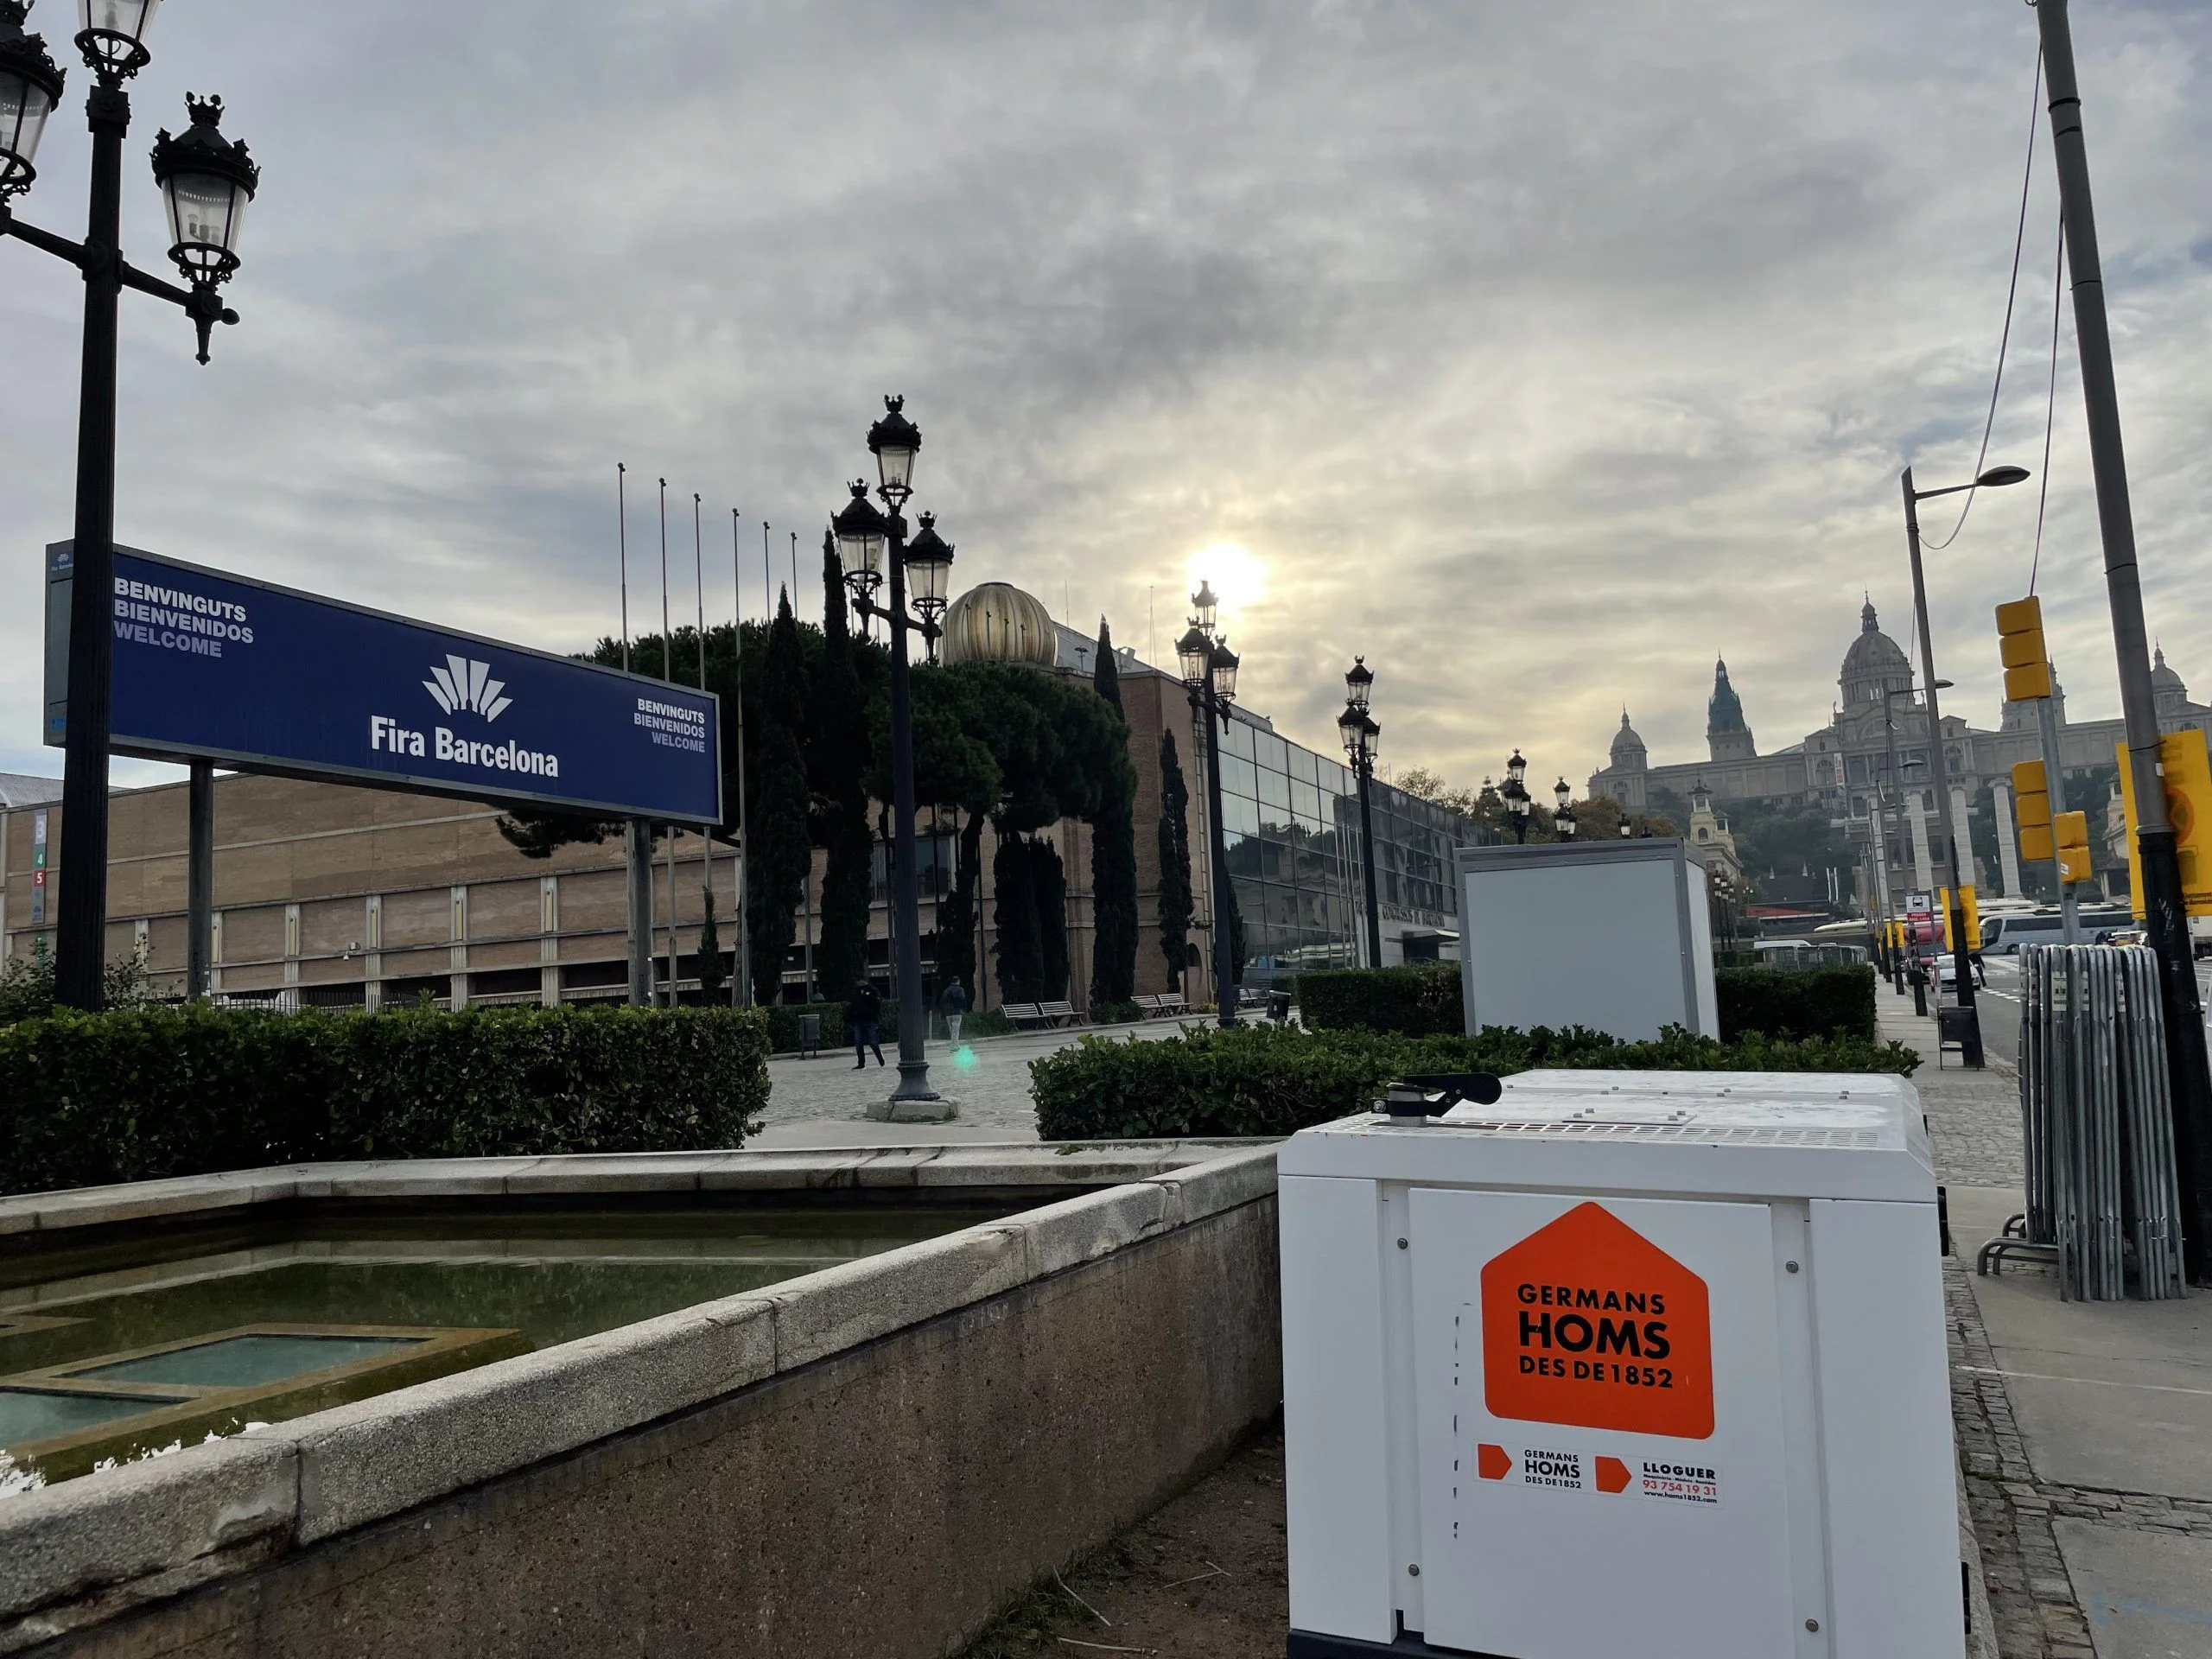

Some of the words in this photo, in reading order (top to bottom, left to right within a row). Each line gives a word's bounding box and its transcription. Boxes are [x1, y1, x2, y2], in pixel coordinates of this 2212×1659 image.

[114, 576, 247, 622] BENVINGUTS
[114, 599, 254, 644] BIENVENIDOS
[113, 620, 222, 658] WELCOME
[637, 697, 705, 724] BENVINGUTS
[633, 712, 705, 739] BIENVENIDOS
[371, 715, 426, 758] Fira
[435, 726, 559, 778] Barcelona
[652, 731, 706, 753] WELCOME
[37, 852, 43, 865] 4
[36, 872, 43, 885] 5
[1517, 1283, 1665, 1315] GERMANS
[1518, 1310, 1671, 1360] HOMS
[1519, 1355, 1566, 1377] DES
[1573, 1360, 1605, 1382] DE
[1610, 1363, 1674, 1389] 1852
[1524, 1449, 1579, 1463] GERMANS
[1525, 1459, 1580, 1478] HOMS
[1643, 1462, 1716, 1480] LLOGUER
[1525, 1475, 1543, 1484] DES
[1545, 1478, 1557, 1486] DE
[1558, 1479, 1581, 1489] 1852
[1643, 1479, 1657, 1490] 93
[1661, 1481, 1682, 1492] 754
[1687, 1484, 1700, 1494] 19
[1703, 1486, 1717, 1497] 31
[1643, 1491, 1718, 1503] www.homs1852.com
